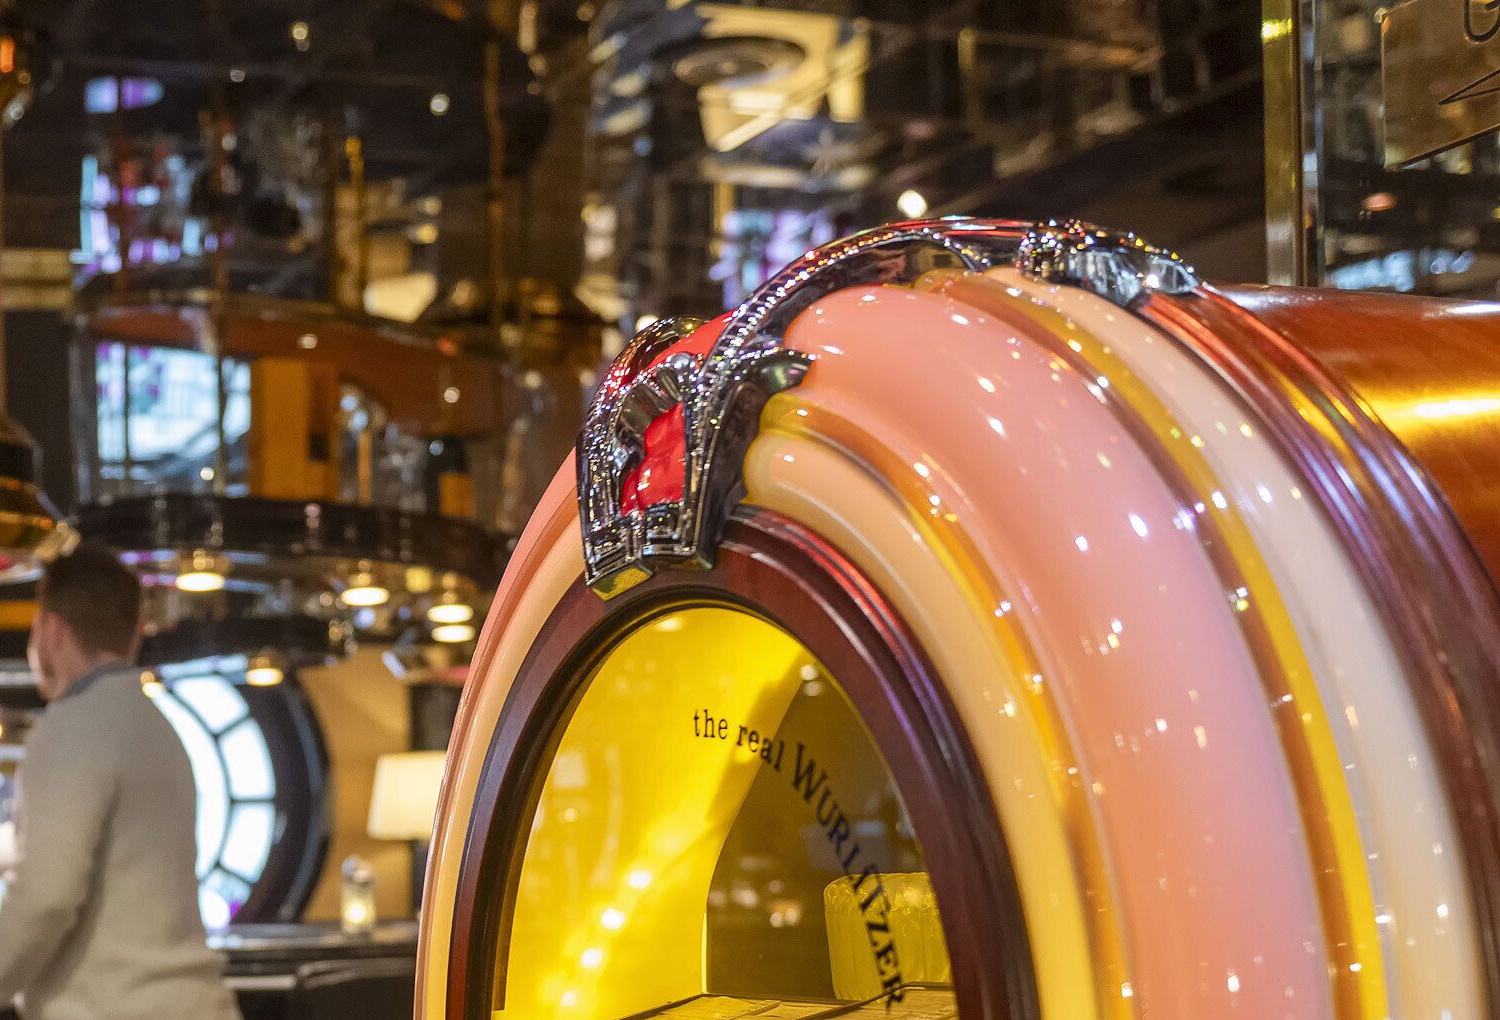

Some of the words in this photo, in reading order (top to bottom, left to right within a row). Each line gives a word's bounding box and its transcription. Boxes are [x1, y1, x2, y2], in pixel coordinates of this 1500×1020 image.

[693, 709, 729, 740] the
[736, 724, 785, 774] real
[791, 742, 905, 1014] WURLITZER
